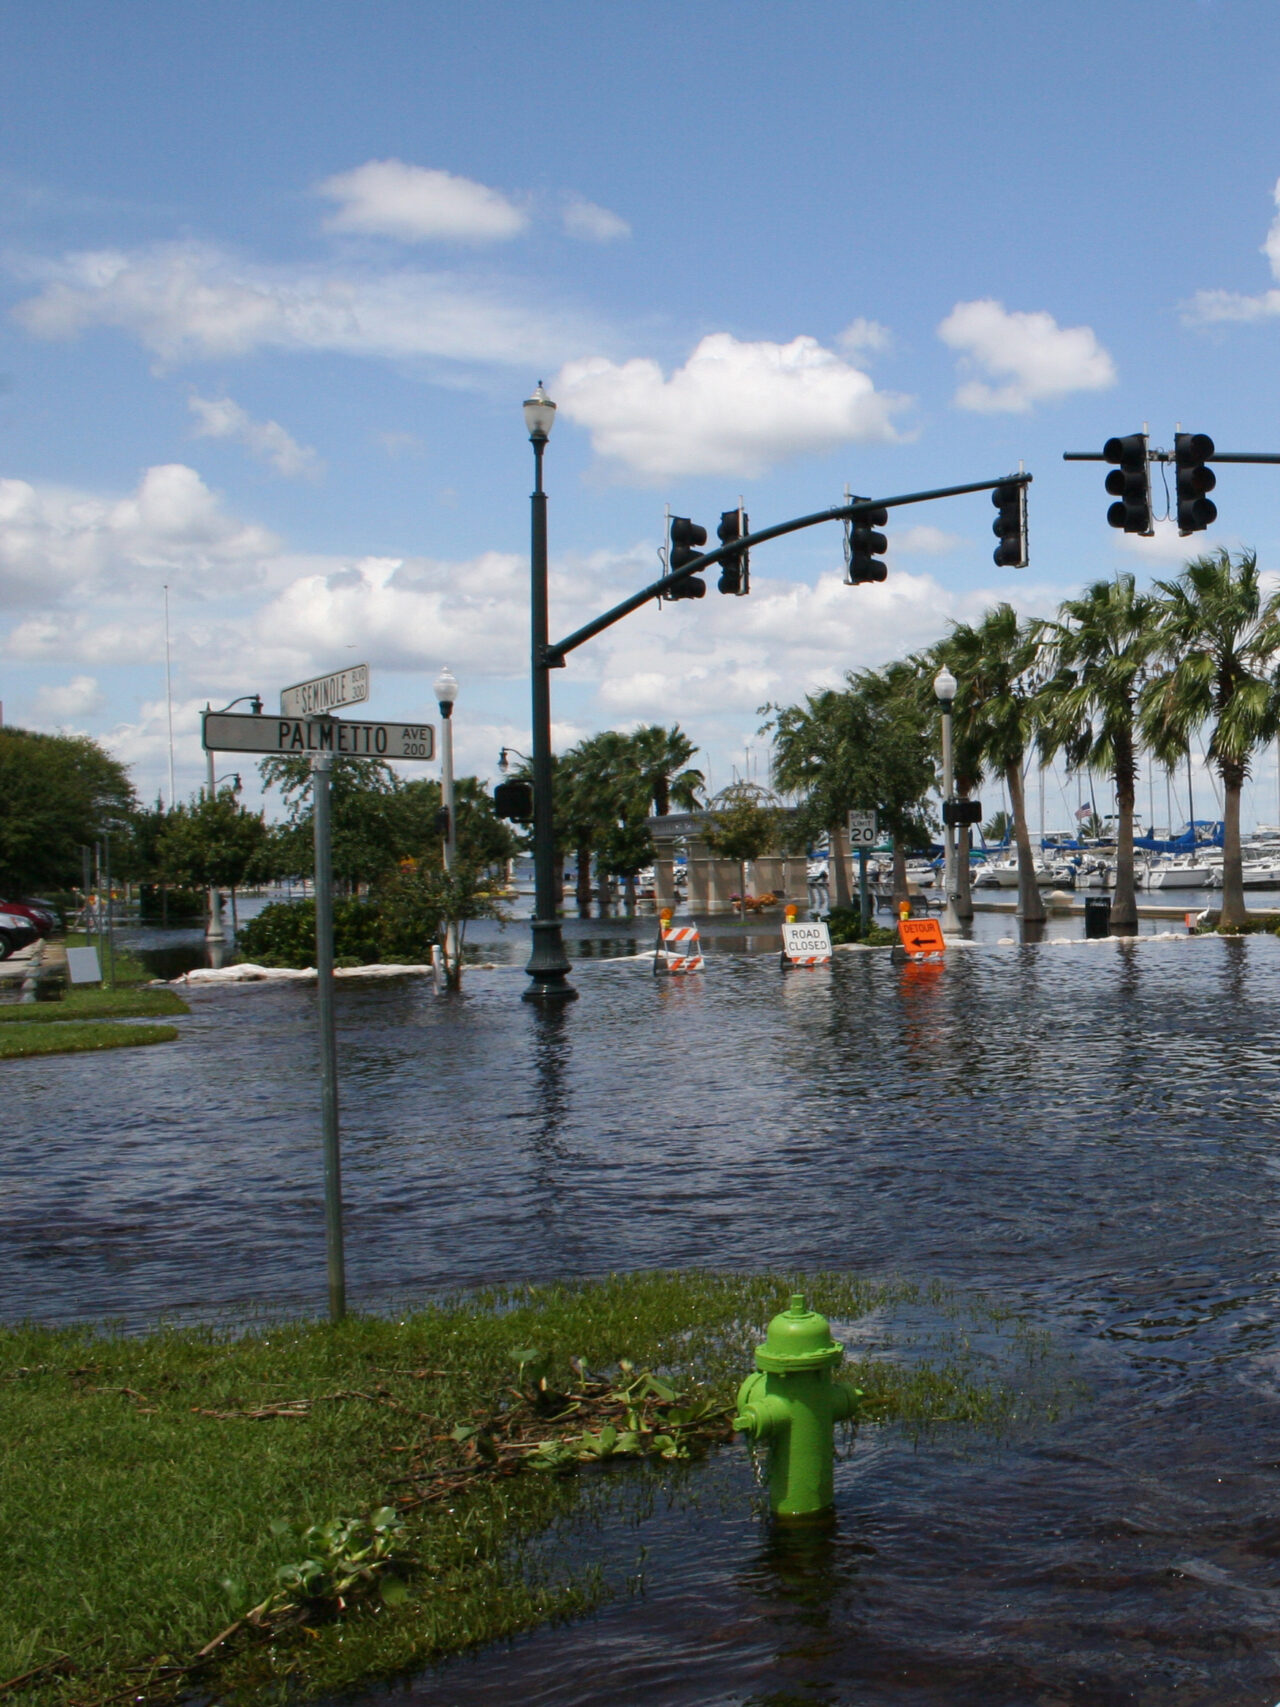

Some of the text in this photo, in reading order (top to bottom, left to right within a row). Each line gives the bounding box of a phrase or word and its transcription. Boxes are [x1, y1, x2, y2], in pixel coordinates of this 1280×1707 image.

[302, 674, 346, 713] SEMINOLE
[352, 668, 365, 683] BLVD
[352, 685, 365, 699] 300
[278, 722, 427, 753] PALMETTO AVE
[403, 743, 426, 756] 200
[851, 828, 874, 841] 20
[791, 929, 821, 939] ROAD
[904, 923, 935, 934] DETOUR
[788, 941, 827, 951] CLOSED
